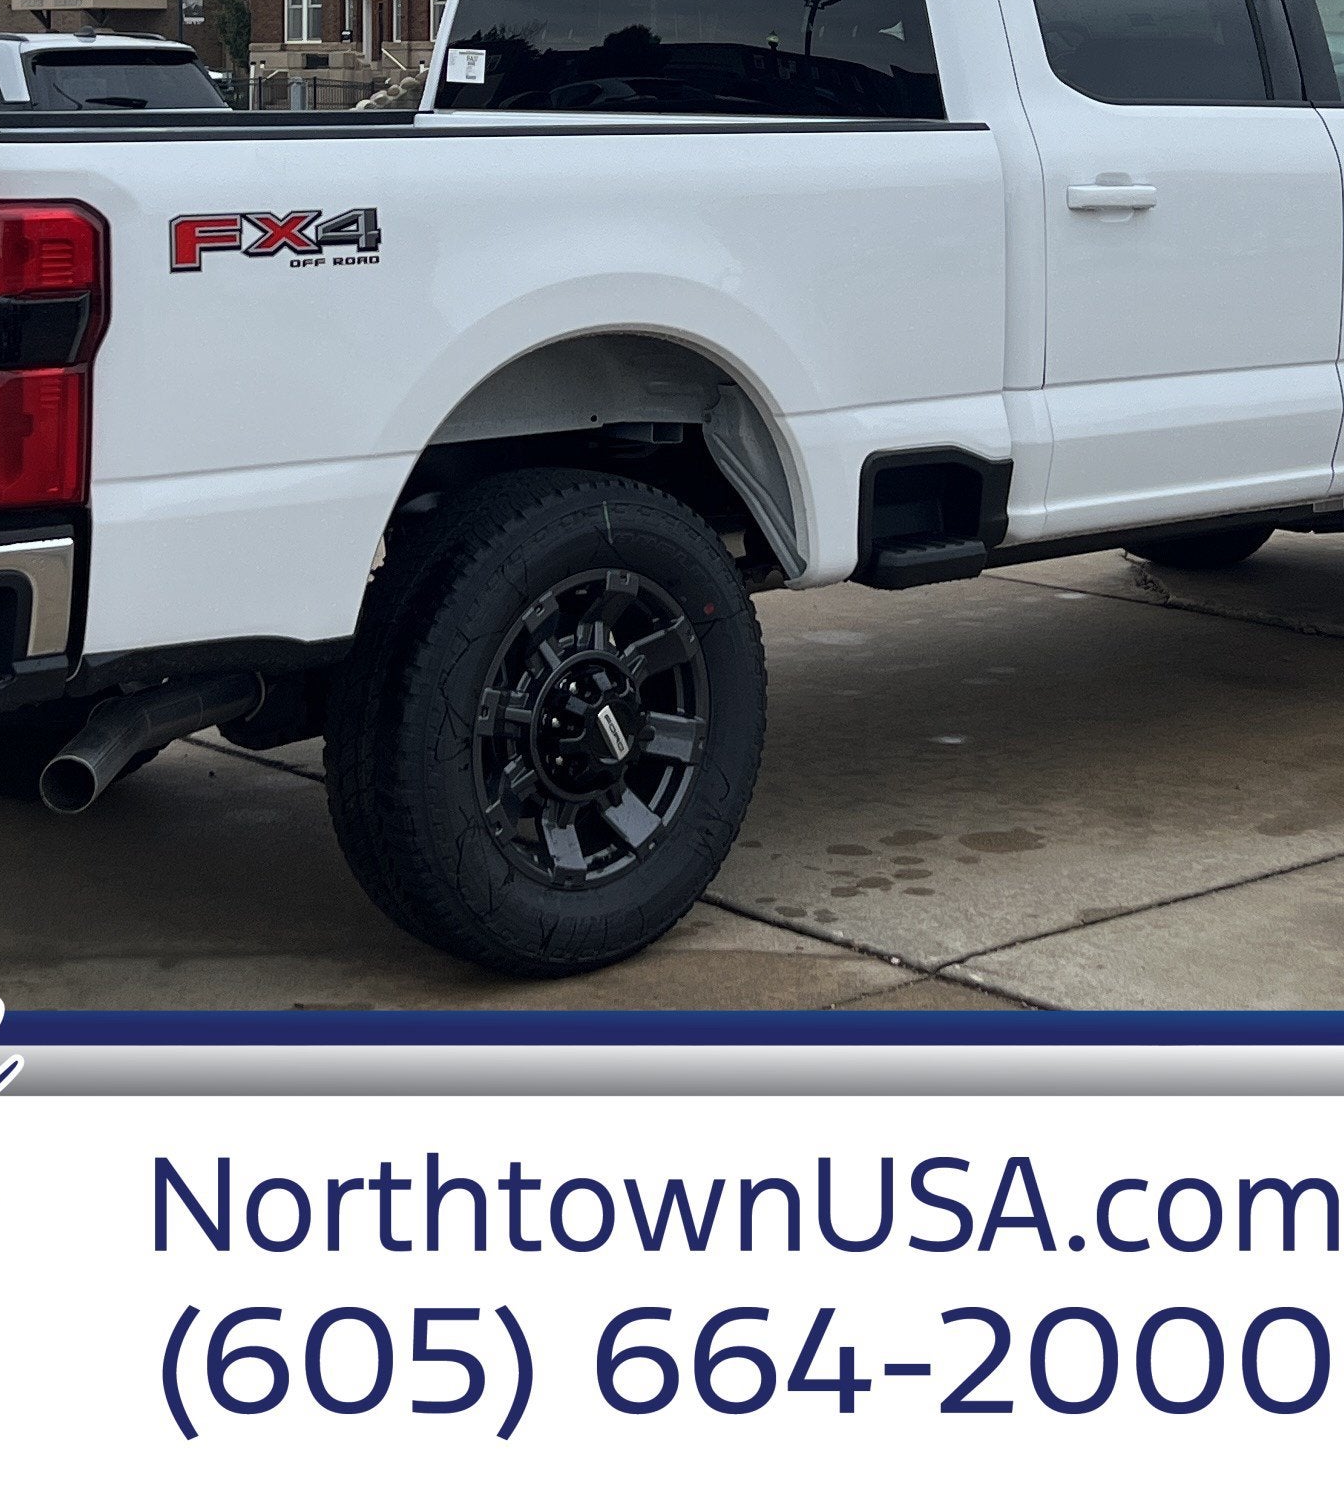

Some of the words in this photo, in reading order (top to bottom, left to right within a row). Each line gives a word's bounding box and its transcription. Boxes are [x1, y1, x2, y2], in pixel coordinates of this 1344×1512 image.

[168, 206, 383, 275] FX4
[289, 258, 326, 268] OFF
[332, 255, 381, 266] ROAD
[603, 713, 625, 753] FORD
